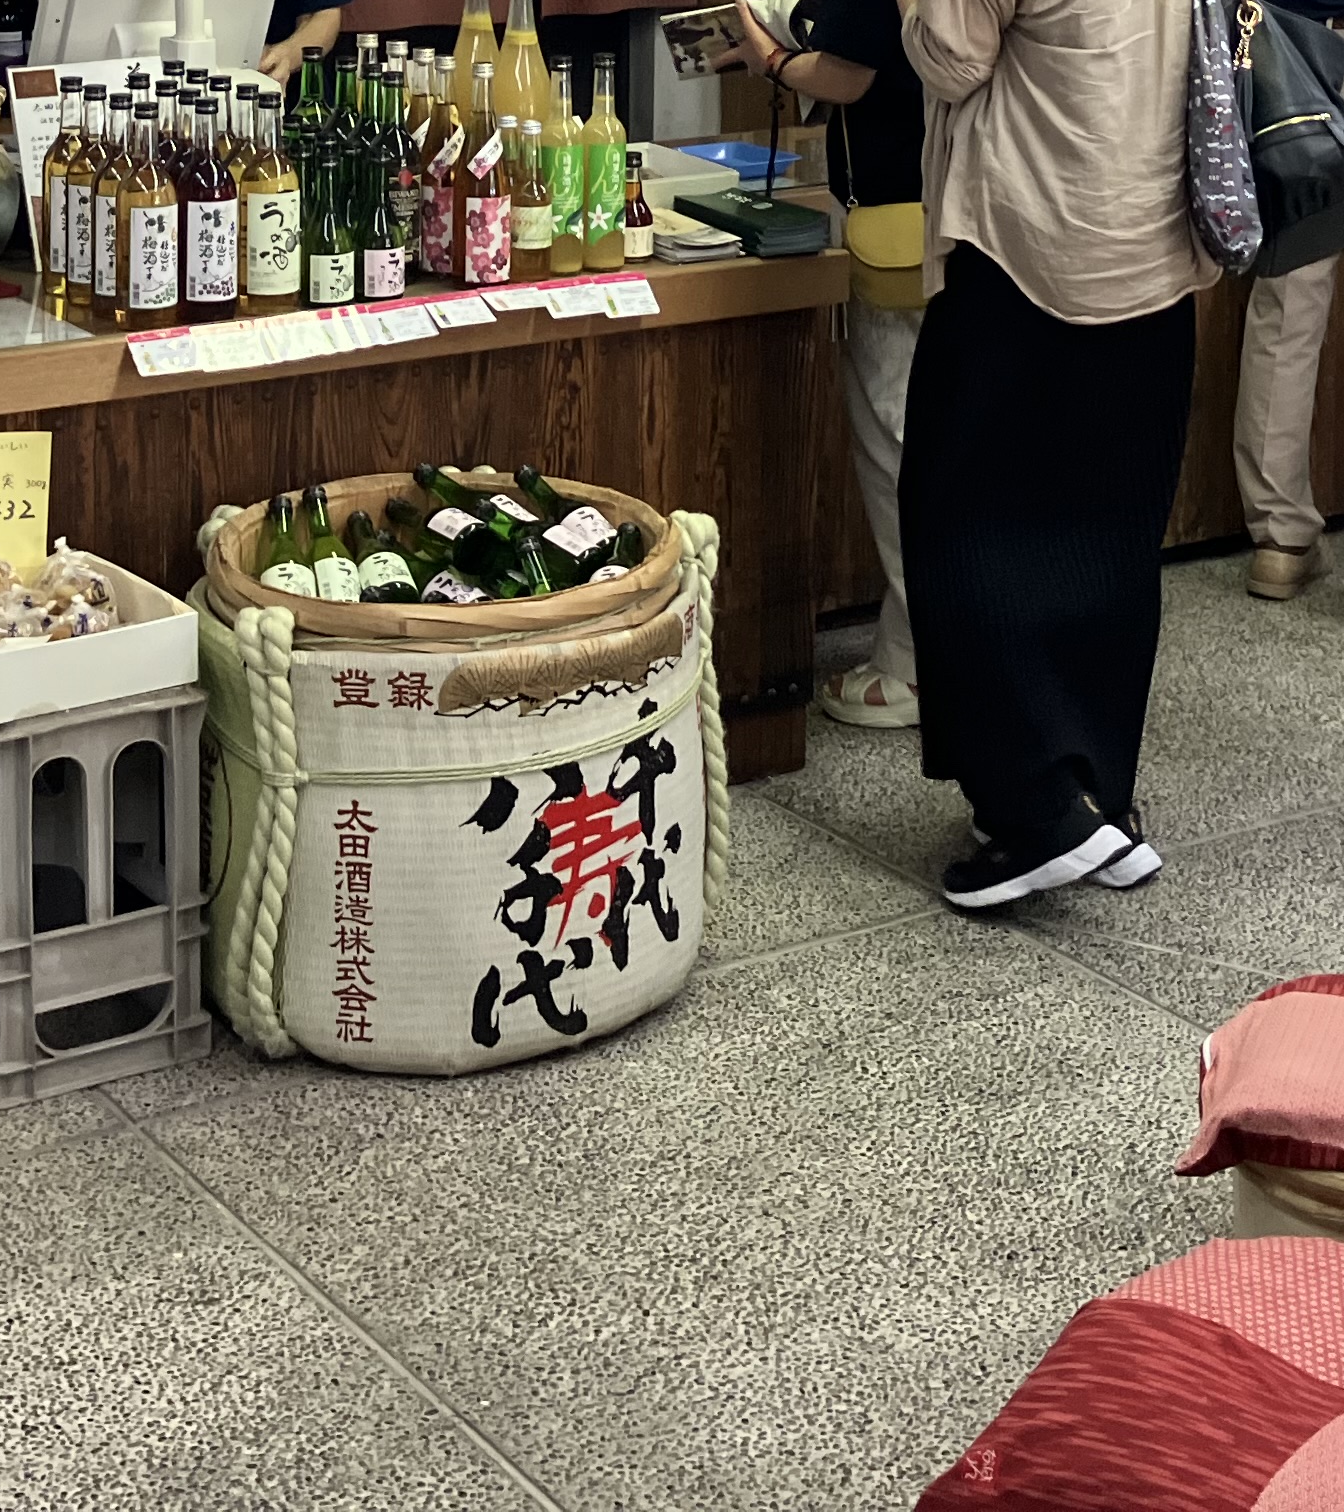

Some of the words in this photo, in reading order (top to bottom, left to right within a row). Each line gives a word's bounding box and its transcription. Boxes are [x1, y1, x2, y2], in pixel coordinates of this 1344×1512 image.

[332, 669, 434, 710] 登録
[330, 800, 377, 1044] 太田酒造株式会社
